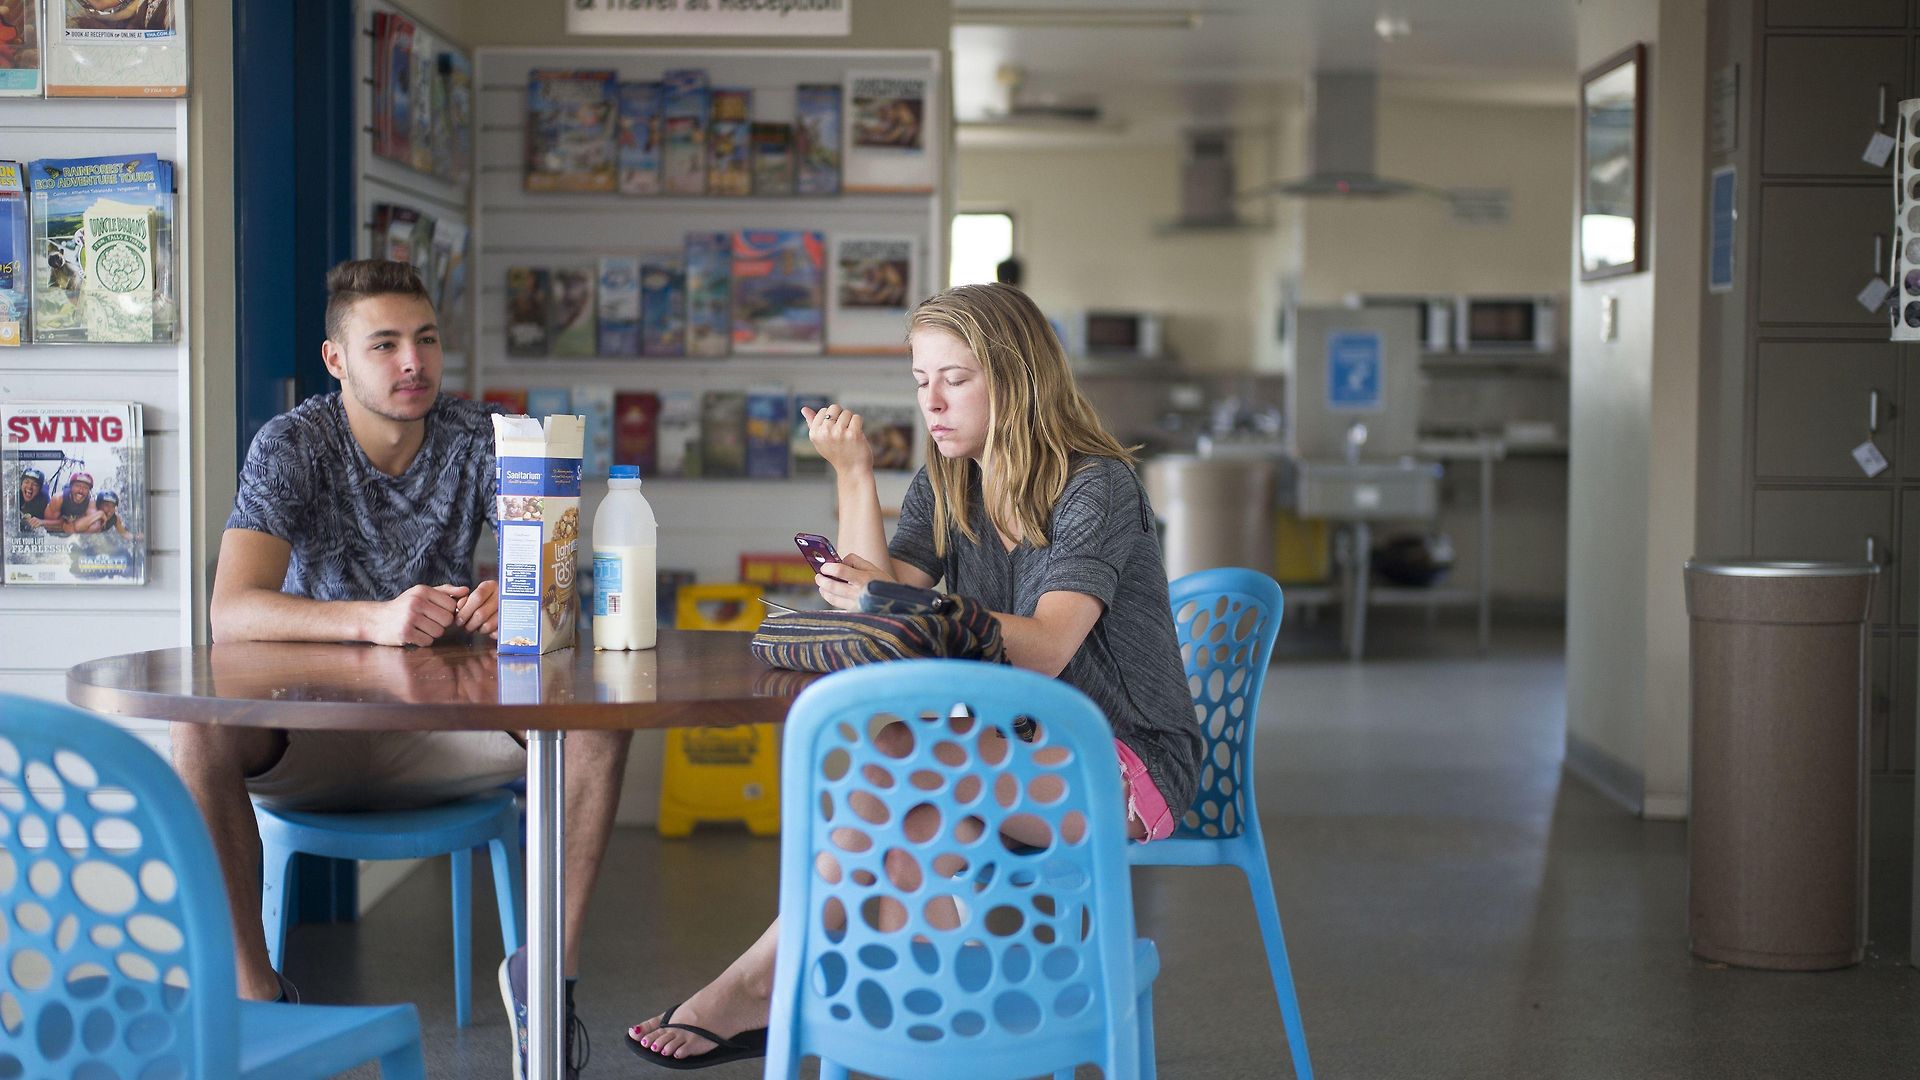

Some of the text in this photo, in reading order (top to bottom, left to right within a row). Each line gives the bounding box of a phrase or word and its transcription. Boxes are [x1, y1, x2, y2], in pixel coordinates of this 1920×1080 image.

[62, 163, 125, 178] RAINFOREST
[34, 178, 55, 190] ECO
[58, 174, 118, 189] ADVENTURE
[7, 415, 123, 443] SWING
[506, 470, 541, 480] Sanitarium
[11, 545, 73, 554] FEARLESSLY
